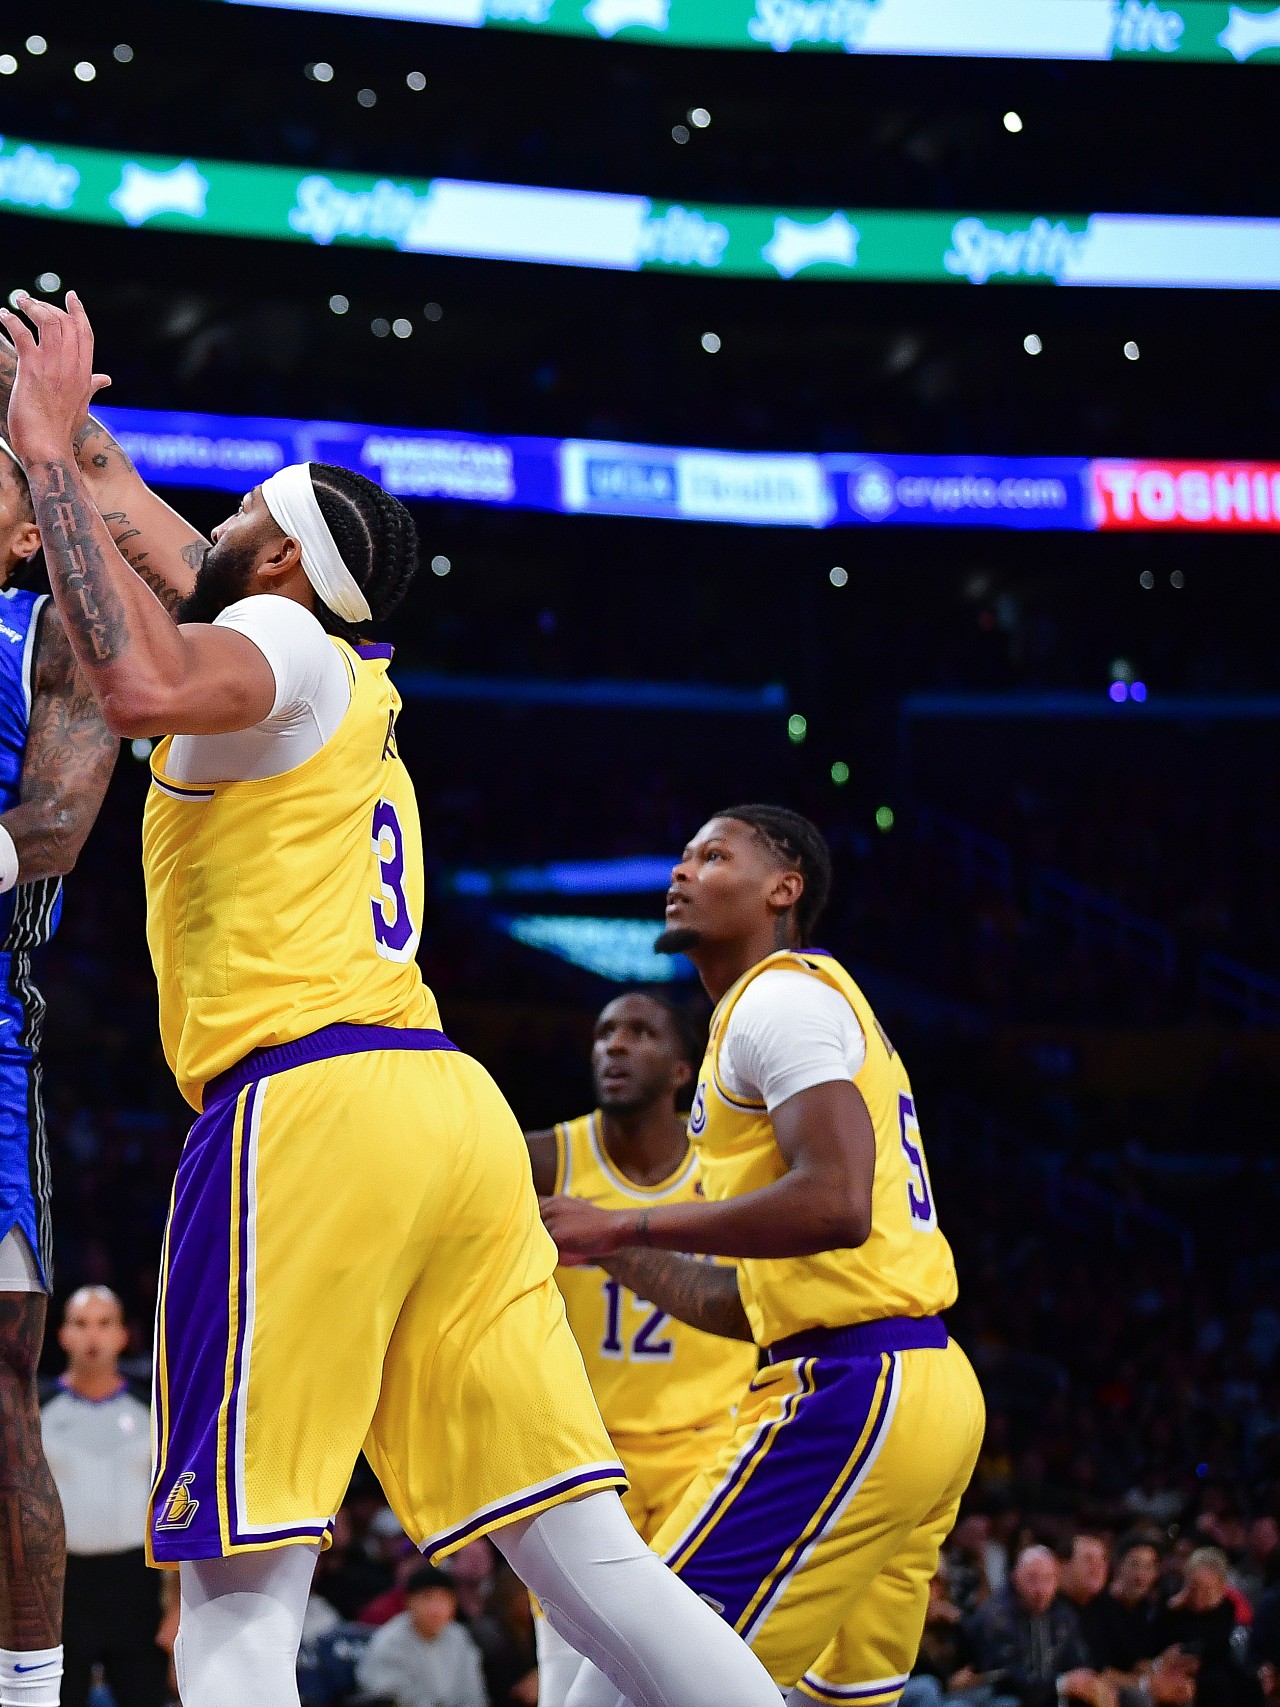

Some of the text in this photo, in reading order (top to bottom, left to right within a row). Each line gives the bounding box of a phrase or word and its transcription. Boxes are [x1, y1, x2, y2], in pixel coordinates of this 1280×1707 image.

[896, 474, 1067, 513] crypto.com
[370, 796, 420, 965] 3
[897, 1088, 938, 1235] 5
[599, 1276, 675, 1363] 12
